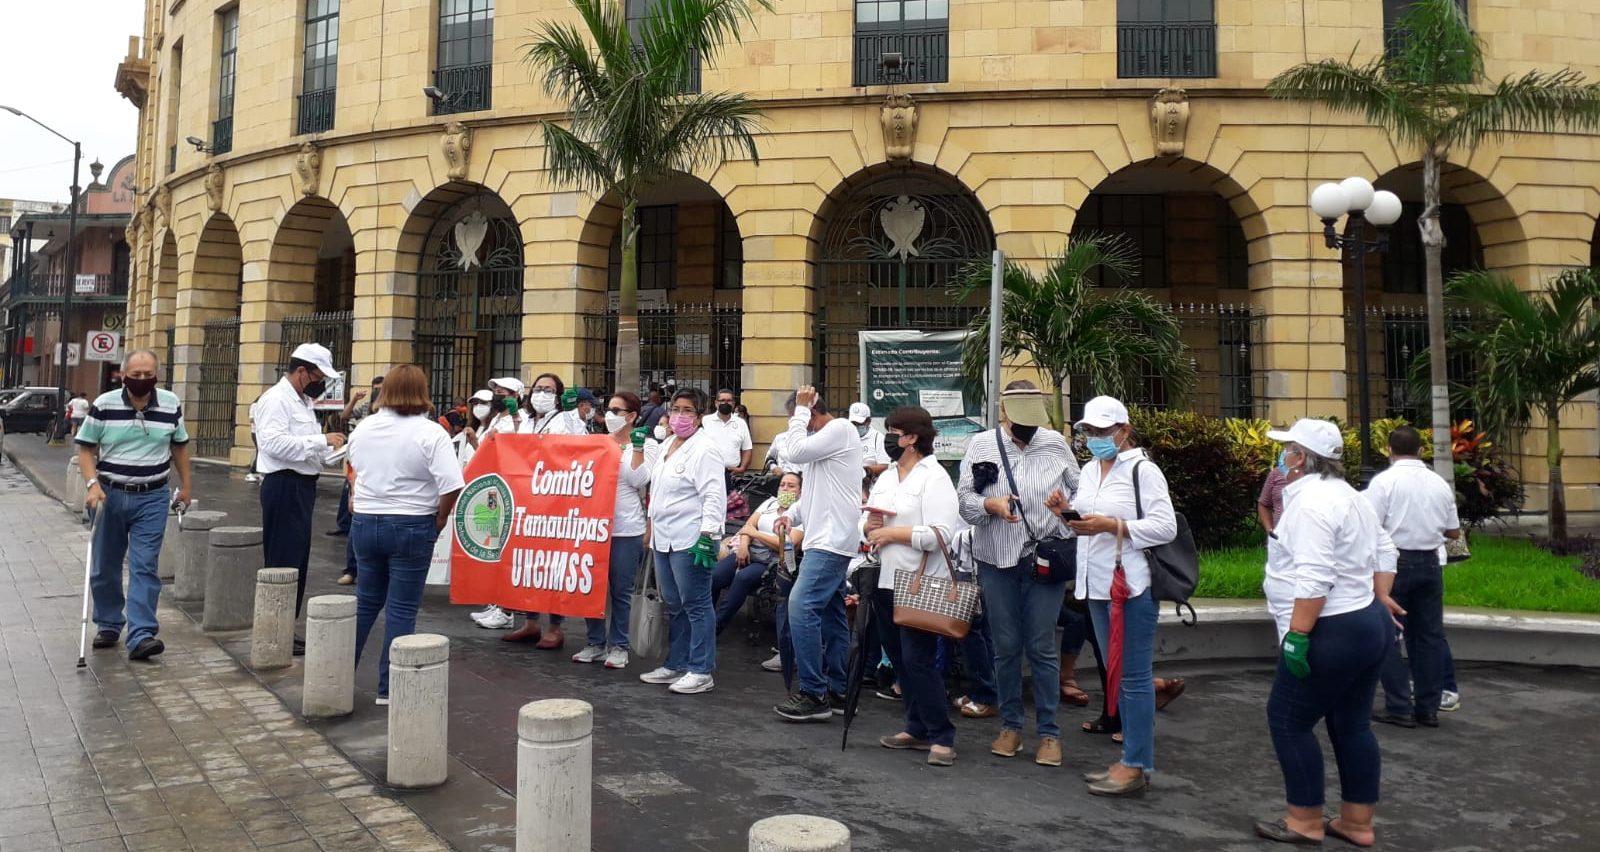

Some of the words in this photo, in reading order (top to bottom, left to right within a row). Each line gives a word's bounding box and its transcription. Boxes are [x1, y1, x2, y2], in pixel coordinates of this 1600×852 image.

[531, 460, 594, 497] Comité
[514, 506, 609, 548] Tamaulipas
[511, 547, 594, 594] UNCIMSS
